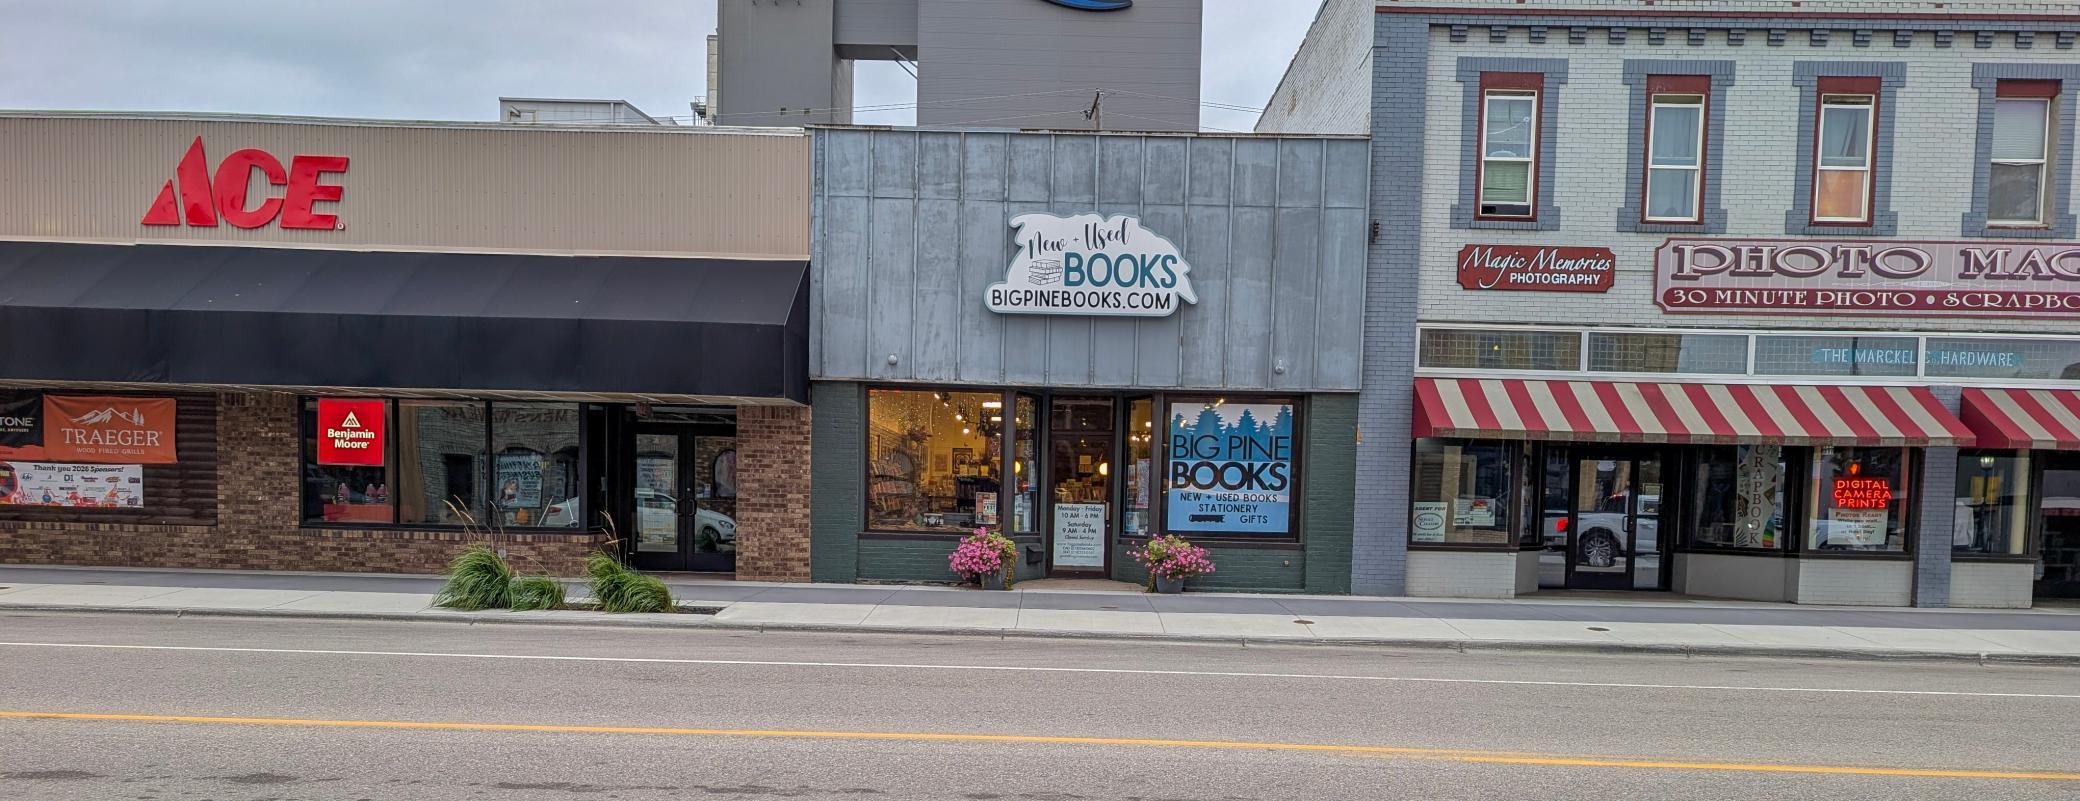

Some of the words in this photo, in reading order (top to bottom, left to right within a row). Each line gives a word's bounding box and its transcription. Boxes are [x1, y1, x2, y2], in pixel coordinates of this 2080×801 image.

[141, 135, 349, 229] ACE
[1028, 231, 1068, 259] New
[1084, 217, 1131, 250] Used
[1463, 246, 1528, 289] Magic
[1528, 248, 1612, 273] Memories
[1671, 244, 1933, 280] PHOTO
[1063, 252, 1178, 289] BOOKS
[1509, 272, 1601, 285] PHOTOGRAPHY
[991, 289, 1171, 310] BIGPINEBOOKS.COM
[1672, 289, 1708, 304] 30
[1714, 290, 1807, 306] MINUTE
[1815, 291, 1917, 307] PHOTO
[1943, 292, 2080, 309] SCRAPBO
[1820, 348, 1849, 363] THE
[1854, 349, 1917, 365] MARCKEL
[1941, 350, 2015, 368] HARDWARE
[60, 428, 160, 447] TRAEGER
[327, 428, 375, 441] Benjamin
[334, 439, 369, 449] Moore
[1172, 434, 1221, 460] BIG
[1228, 435, 1290, 461] PINE
[33, 464, 58, 472] Thank
[1171, 461, 1288, 491] BOOKS
[1837, 480, 1889, 489] DIGITAL
[1180, 492, 1203, 502] NEW
[1215, 493, 1240, 502] USED
[1242, 493, 1278, 503] BOOKS
[1834, 489, 1892, 499] CAMERA
[1057, 505, 1080, 513] Monday
[1085, 505, 1103, 513] Friday
[1198, 503, 1258, 513] STATIONERY
[1838, 499, 1886, 508] PRINTS
[1239, 514, 1268, 524] GIFTS
